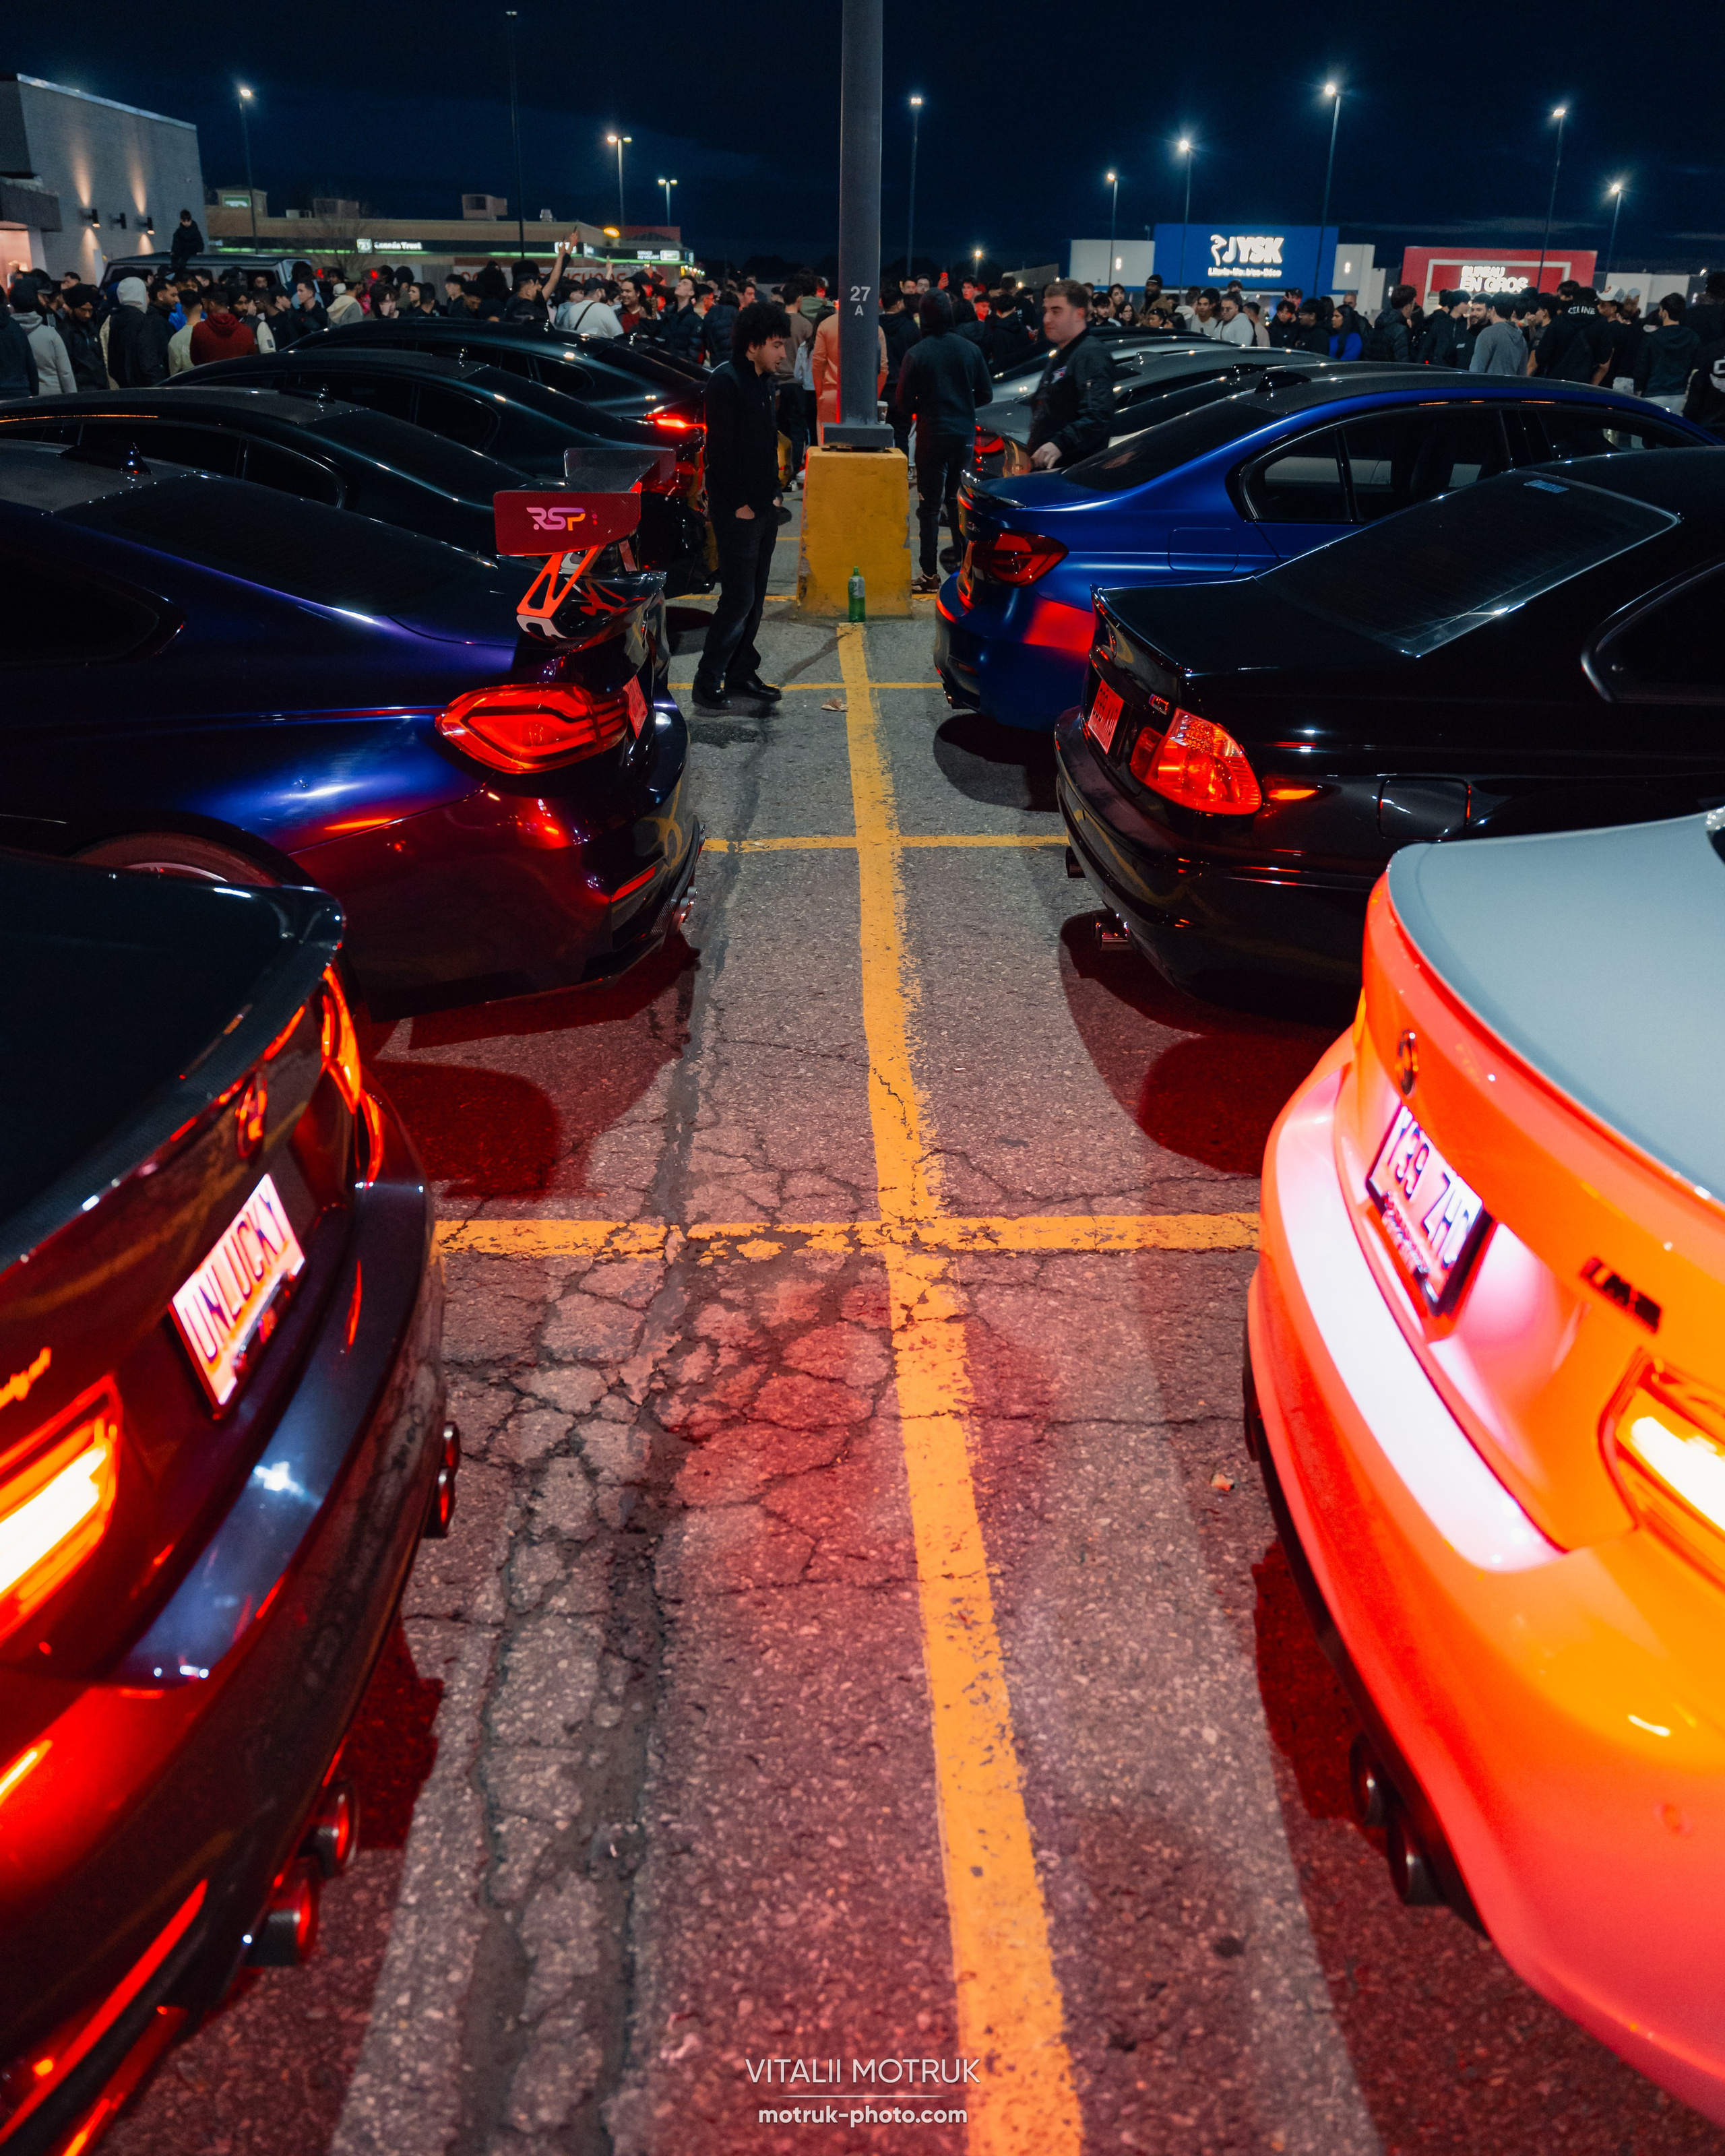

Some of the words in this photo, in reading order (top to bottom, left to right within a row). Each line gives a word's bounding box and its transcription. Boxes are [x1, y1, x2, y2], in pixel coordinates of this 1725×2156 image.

[1222, 236, 1284, 263] JYSK
[1460, 276, 1482, 292] EN
[1484, 277, 1529, 292] GROS
[850, 286, 871, 301] 27
[854, 305, 864, 316] A
[1568, 305, 1596, 315] CELINE
[526, 507, 586, 531] RSP
[182, 1187, 290, 1364] UNLUCKY
